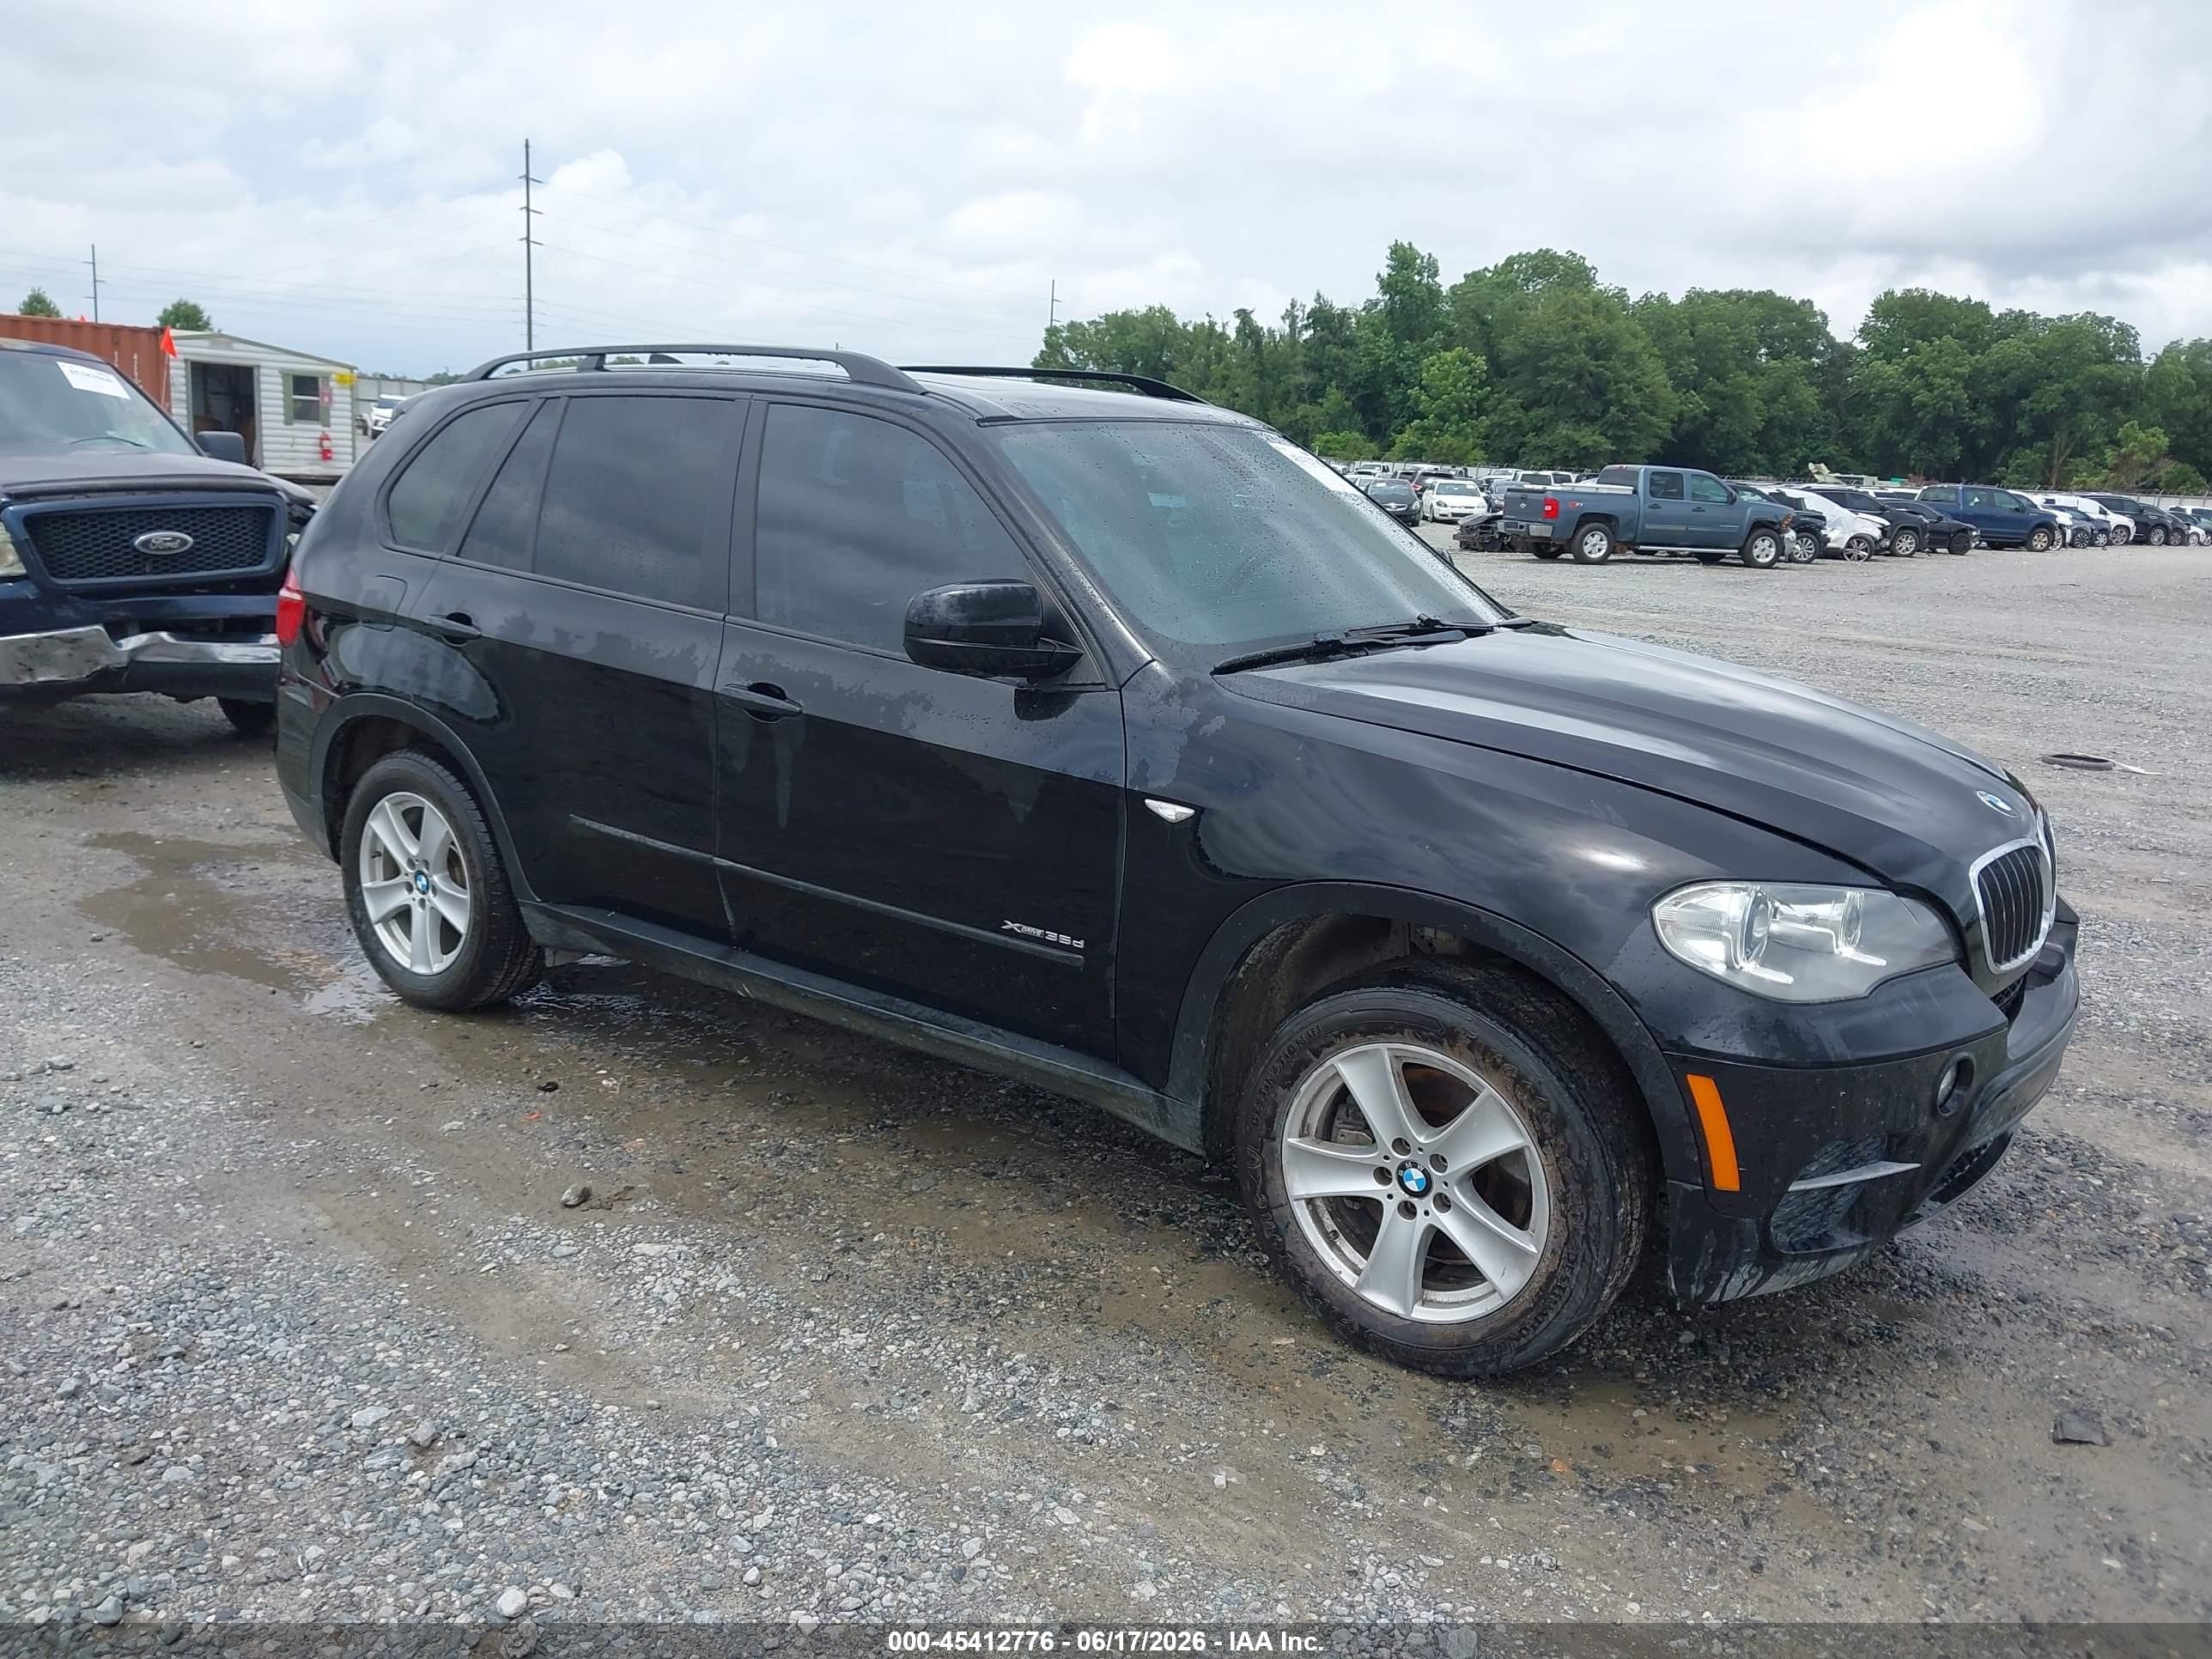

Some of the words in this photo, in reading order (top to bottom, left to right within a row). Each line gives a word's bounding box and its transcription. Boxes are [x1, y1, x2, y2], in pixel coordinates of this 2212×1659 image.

[150, 537, 180, 550] Ford
[1044, 930, 1085, 949] 35d
[1398, 1161, 1425, 1176] BMW
